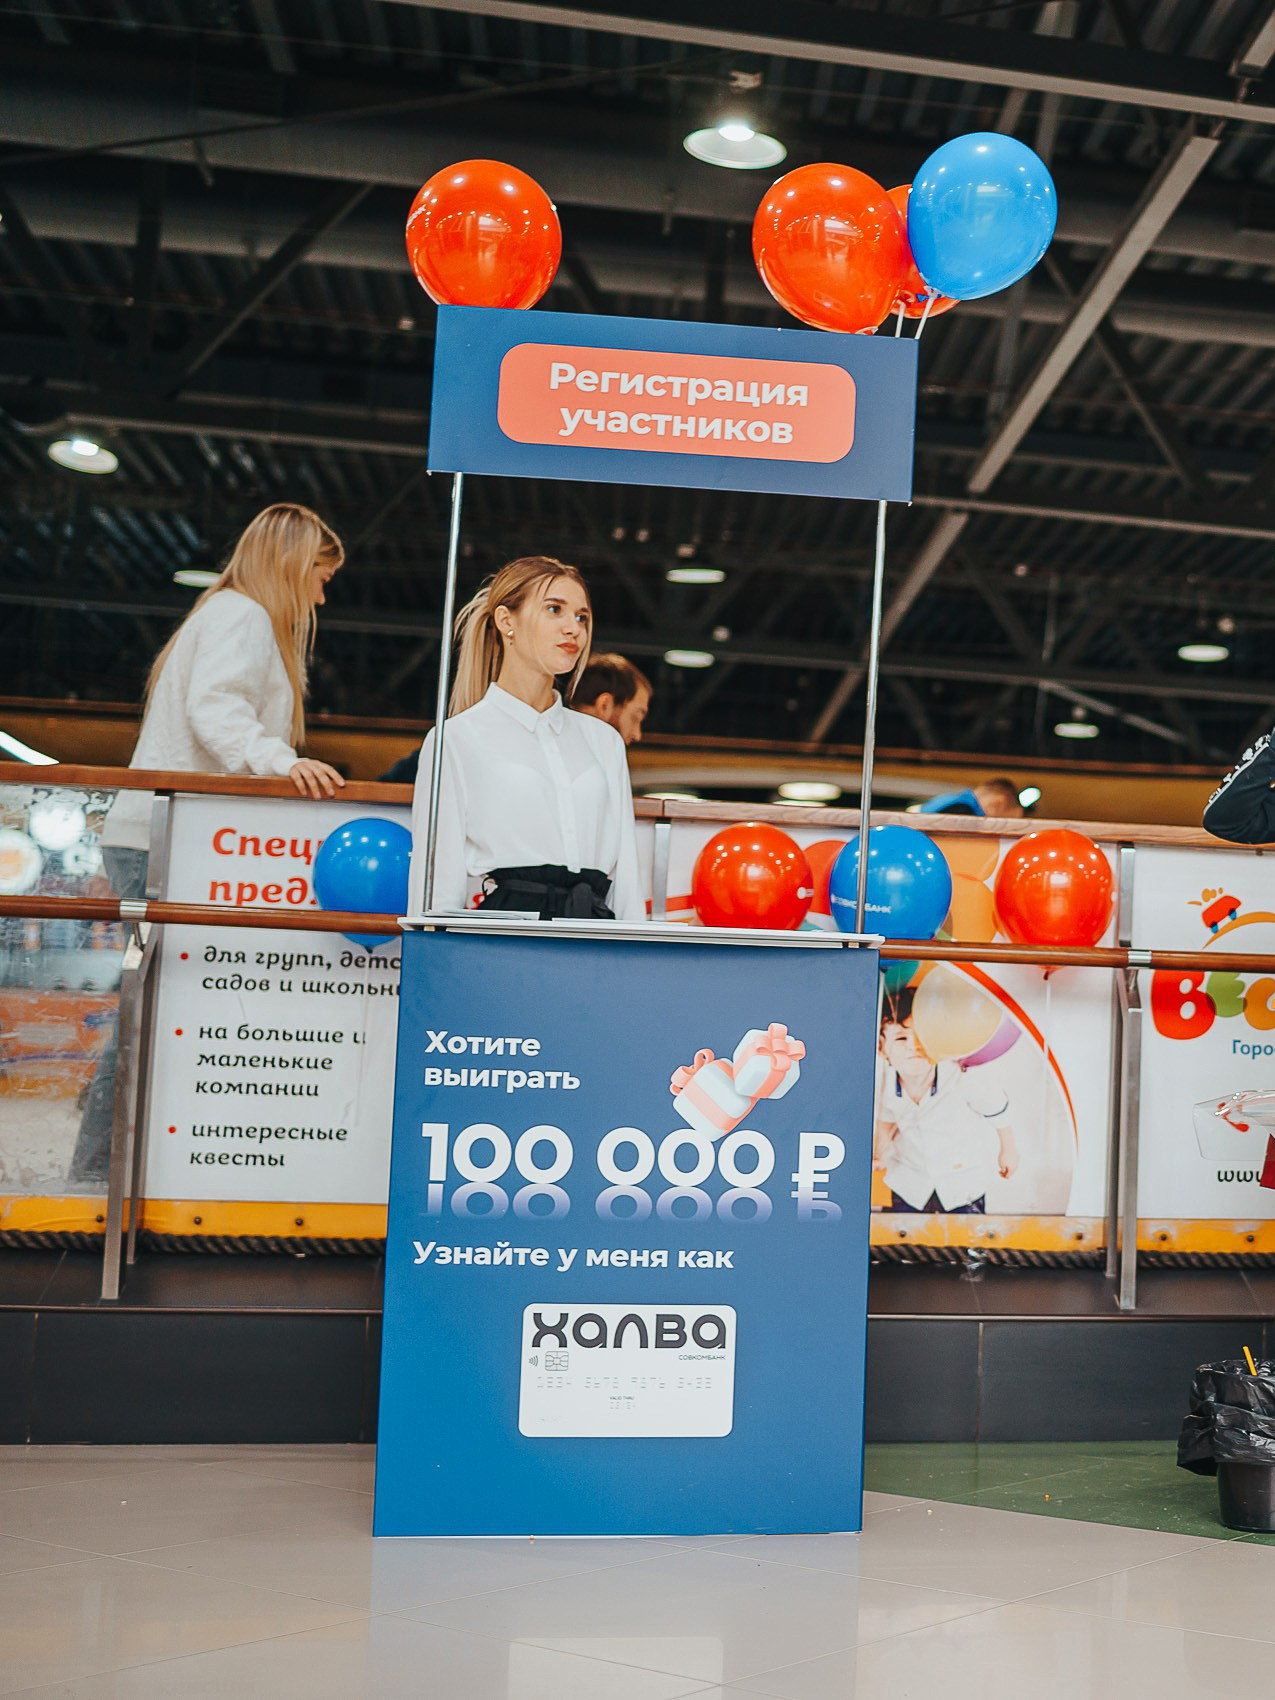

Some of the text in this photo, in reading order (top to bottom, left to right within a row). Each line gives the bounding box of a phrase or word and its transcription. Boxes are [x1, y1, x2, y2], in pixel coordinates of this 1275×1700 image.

[548, 361, 810, 408] Регистрация
[557, 406, 794, 445] участников
[212, 827, 325, 866] Спец
[208, 876, 318, 907] пред
[203, 945, 247, 964] для
[255, 951, 332, 971] групп,
[202, 973, 270, 992] садов
[279, 979, 293, 992] и
[199, 1025, 228, 1040] на
[236, 1023, 344, 1043] большие
[424, 1029, 541, 1057] Хотите
[197, 1053, 334, 1070] маленькие
[195, 1080, 319, 1097] компании
[424, 1065, 581, 1094] выиграть
[192, 1124, 348, 1144] интересные
[190, 1151, 285, 1167] квесты
[421, 1121, 575, 1185] 100
[596, 1126, 776, 1189] 000
[412, 1240, 735, 1272] Узнайте у меня как
